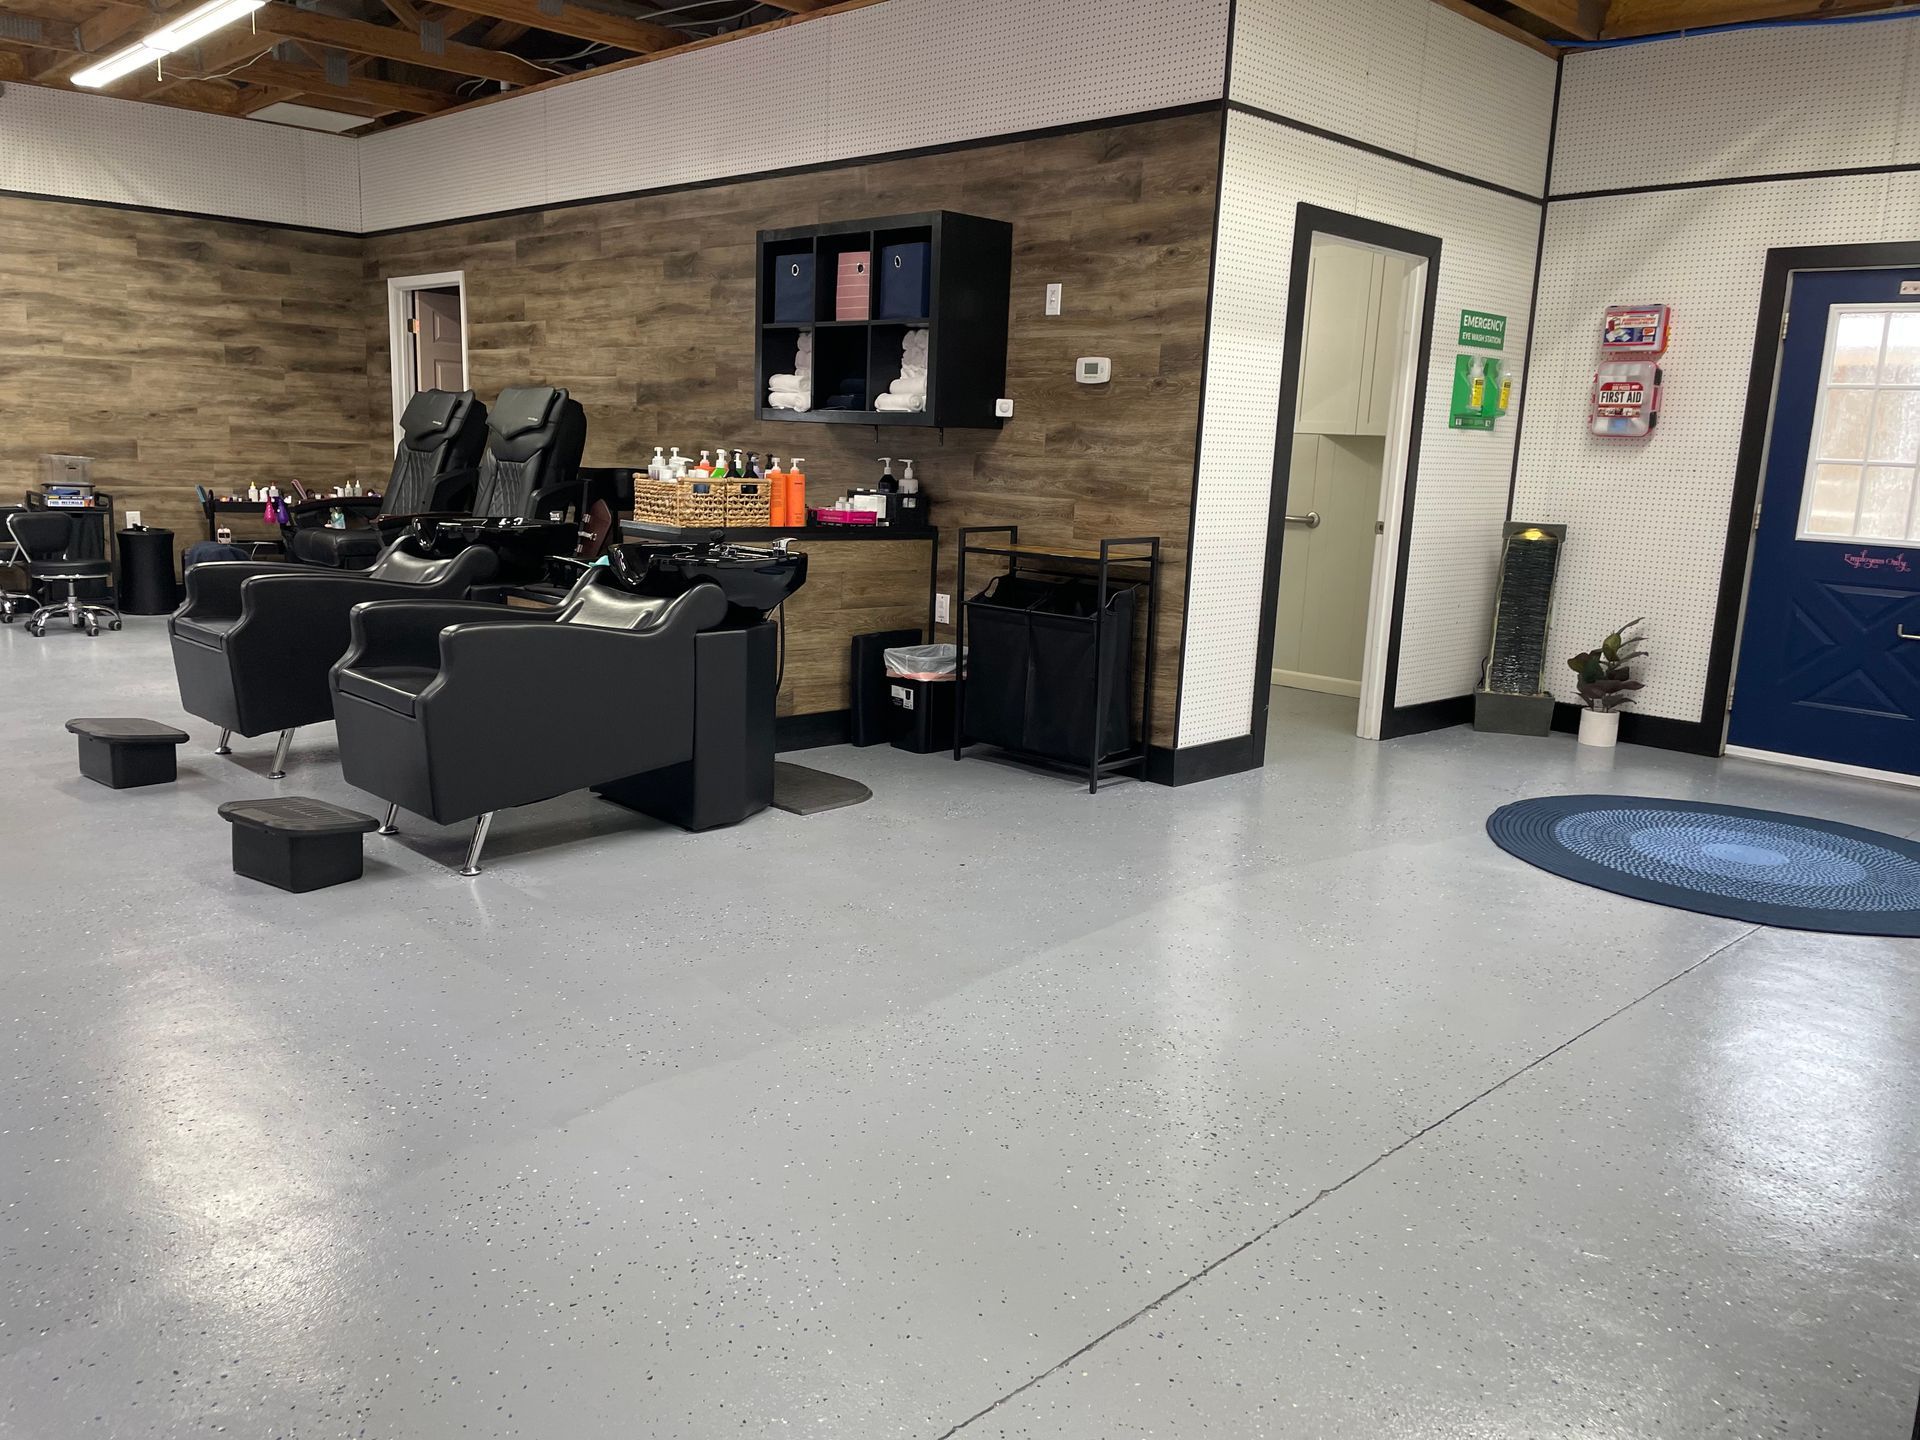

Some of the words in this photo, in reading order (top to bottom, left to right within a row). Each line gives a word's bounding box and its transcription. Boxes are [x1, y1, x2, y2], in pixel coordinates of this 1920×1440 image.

[1464, 315, 1504, 332] EMERGENCY
[1462, 332, 1471, 340] EYE
[1471, 333, 1484, 342] WASH
[1484, 335, 1501, 344] STATION
[1600, 391, 1625, 403] FIRST
[1626, 391, 1642, 403] AID
[1886, 552, 1911, 572] Only
